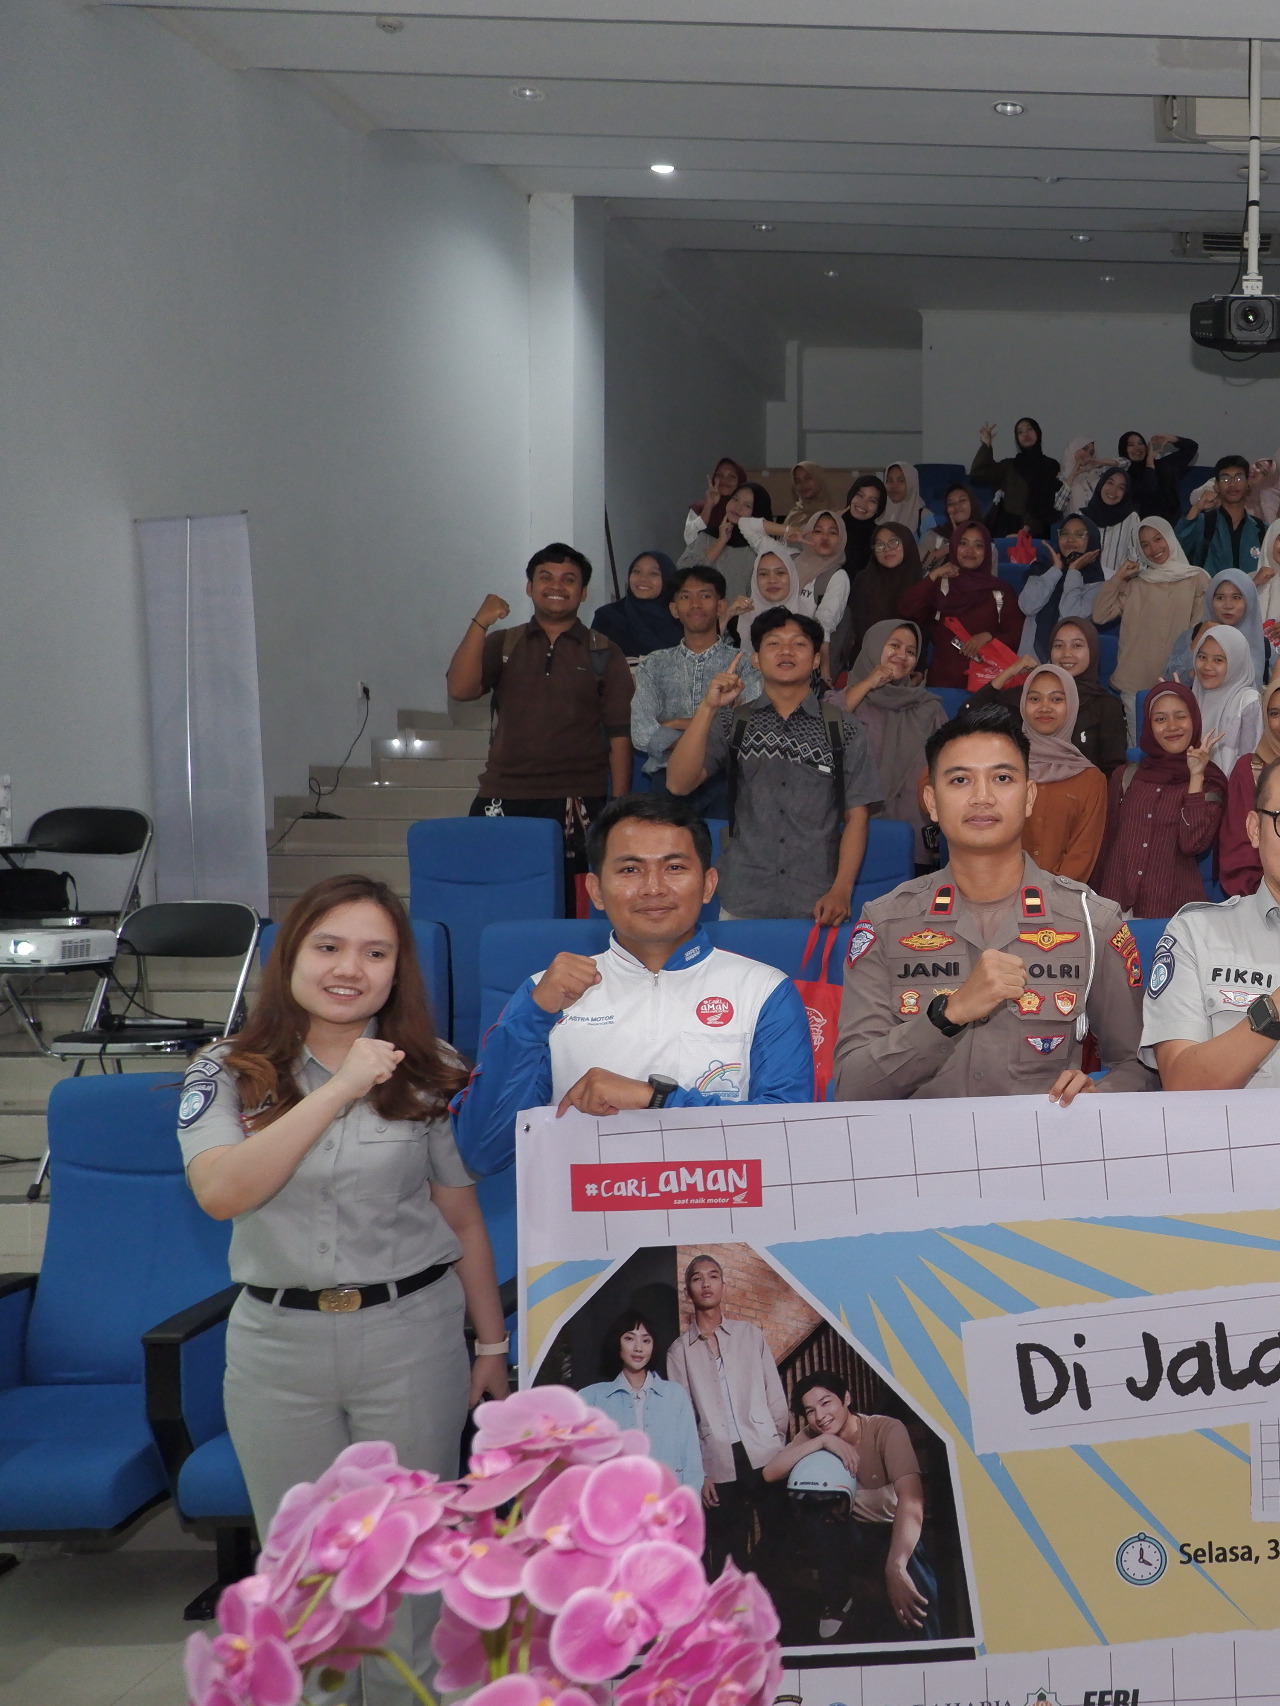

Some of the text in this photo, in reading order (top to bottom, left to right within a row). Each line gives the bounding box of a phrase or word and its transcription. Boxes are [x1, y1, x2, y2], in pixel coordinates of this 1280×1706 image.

[897, 962, 959, 979] JANI
[1029, 963, 1079, 979] OLRI
[1211, 968, 1273, 988] FIKRI
[591, 1014, 615, 1022] MOTOR
[1016, 1333, 1091, 1415] Di
[1179, 1541, 1260, 1564] Selasa,
